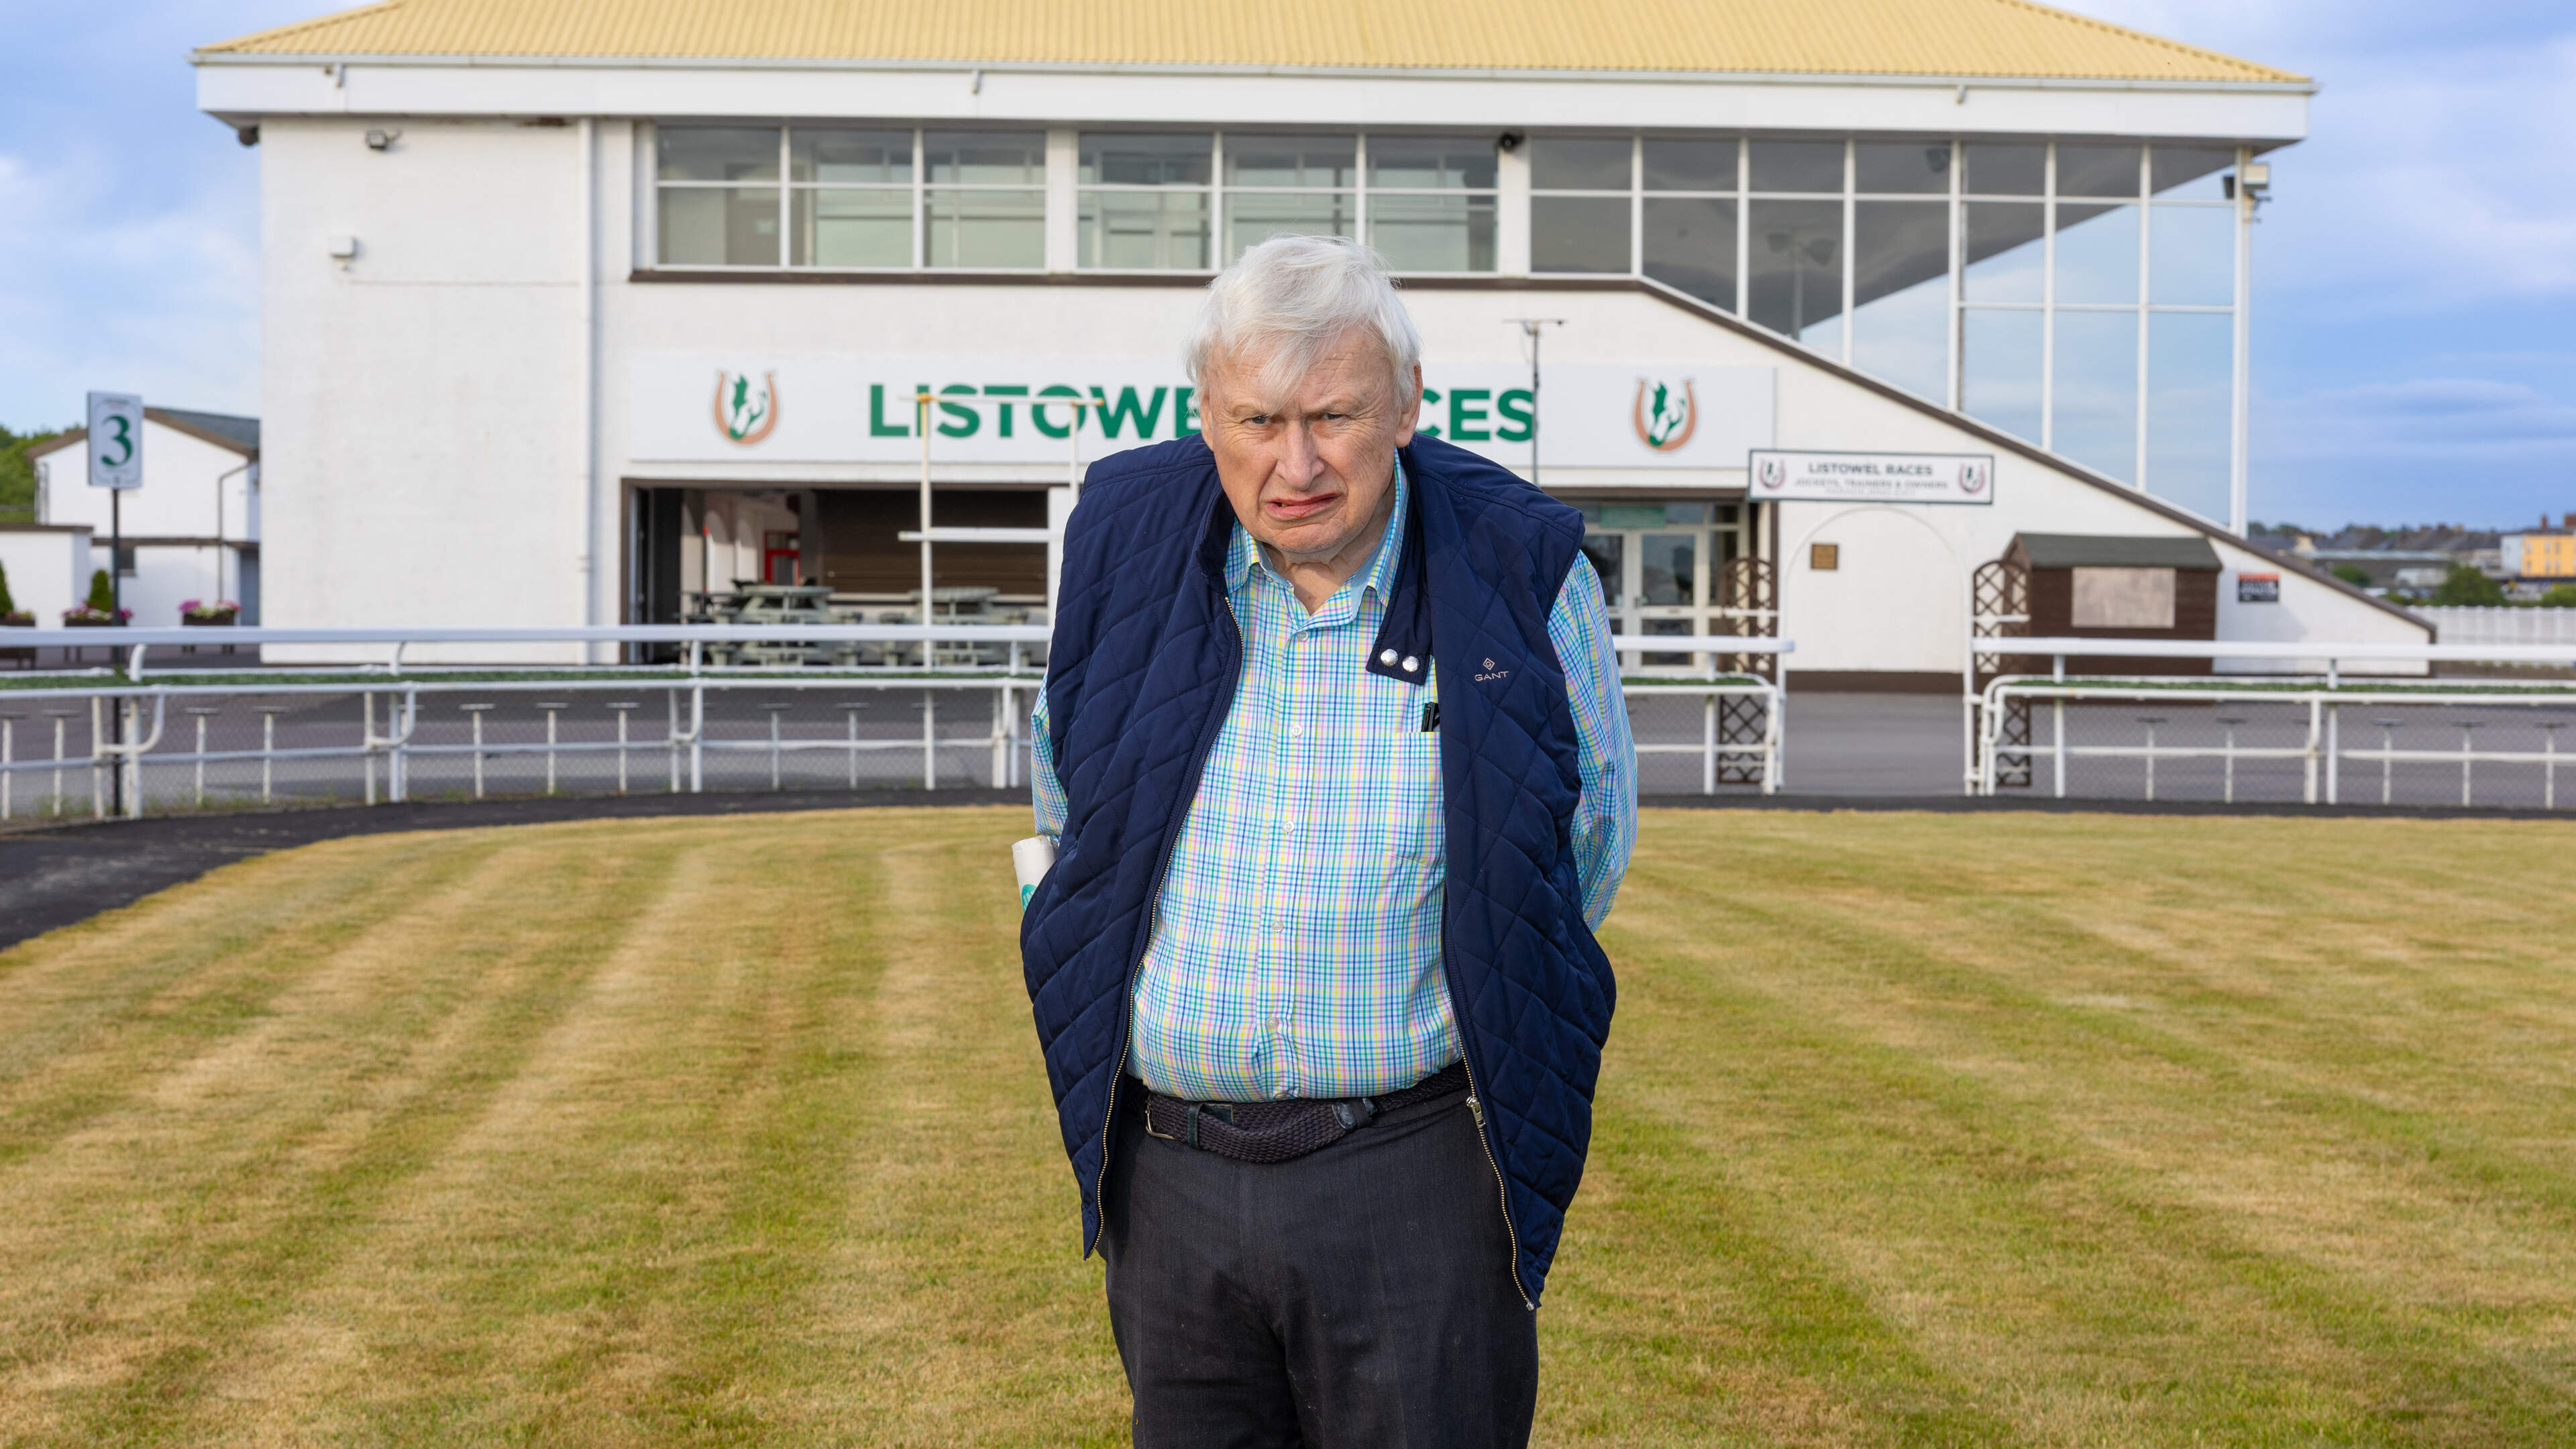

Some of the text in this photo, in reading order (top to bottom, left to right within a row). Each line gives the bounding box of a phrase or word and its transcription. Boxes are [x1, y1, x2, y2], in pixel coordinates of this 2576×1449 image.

[869, 384, 1205, 439] LISTOWE
[100, 413, 133, 468] 3
[1809, 462, 1933, 476] LISTOWEL RACES
[1474, 671, 1509, 681] GANT
